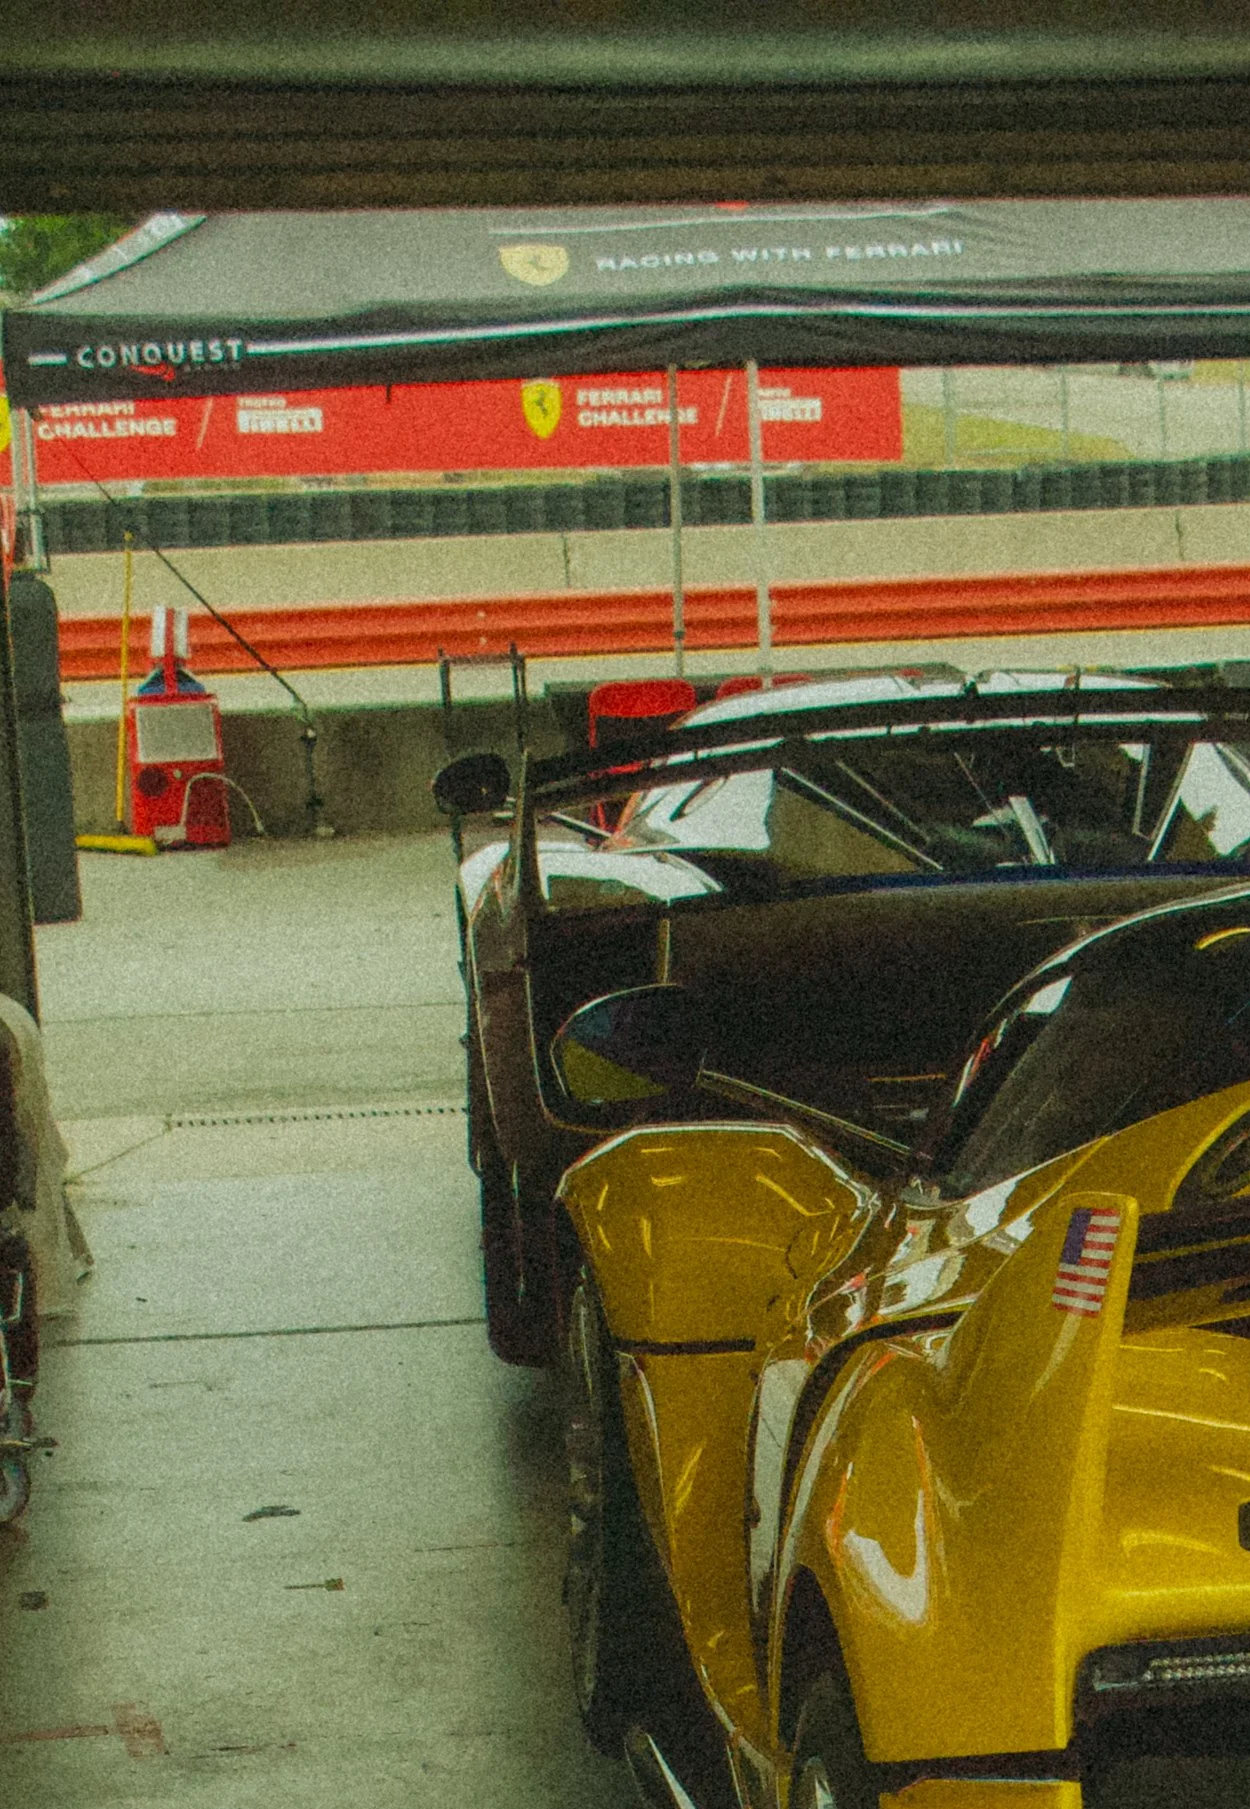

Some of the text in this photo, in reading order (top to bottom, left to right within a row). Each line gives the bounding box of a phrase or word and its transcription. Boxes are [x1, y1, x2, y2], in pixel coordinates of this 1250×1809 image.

[595, 240, 963, 271] RACING WITH FERRARI
[76, 340, 243, 368] CONQUEST
[577, 388, 663, 406] FERRARI
[38, 418, 176, 440] CHALLENGE
